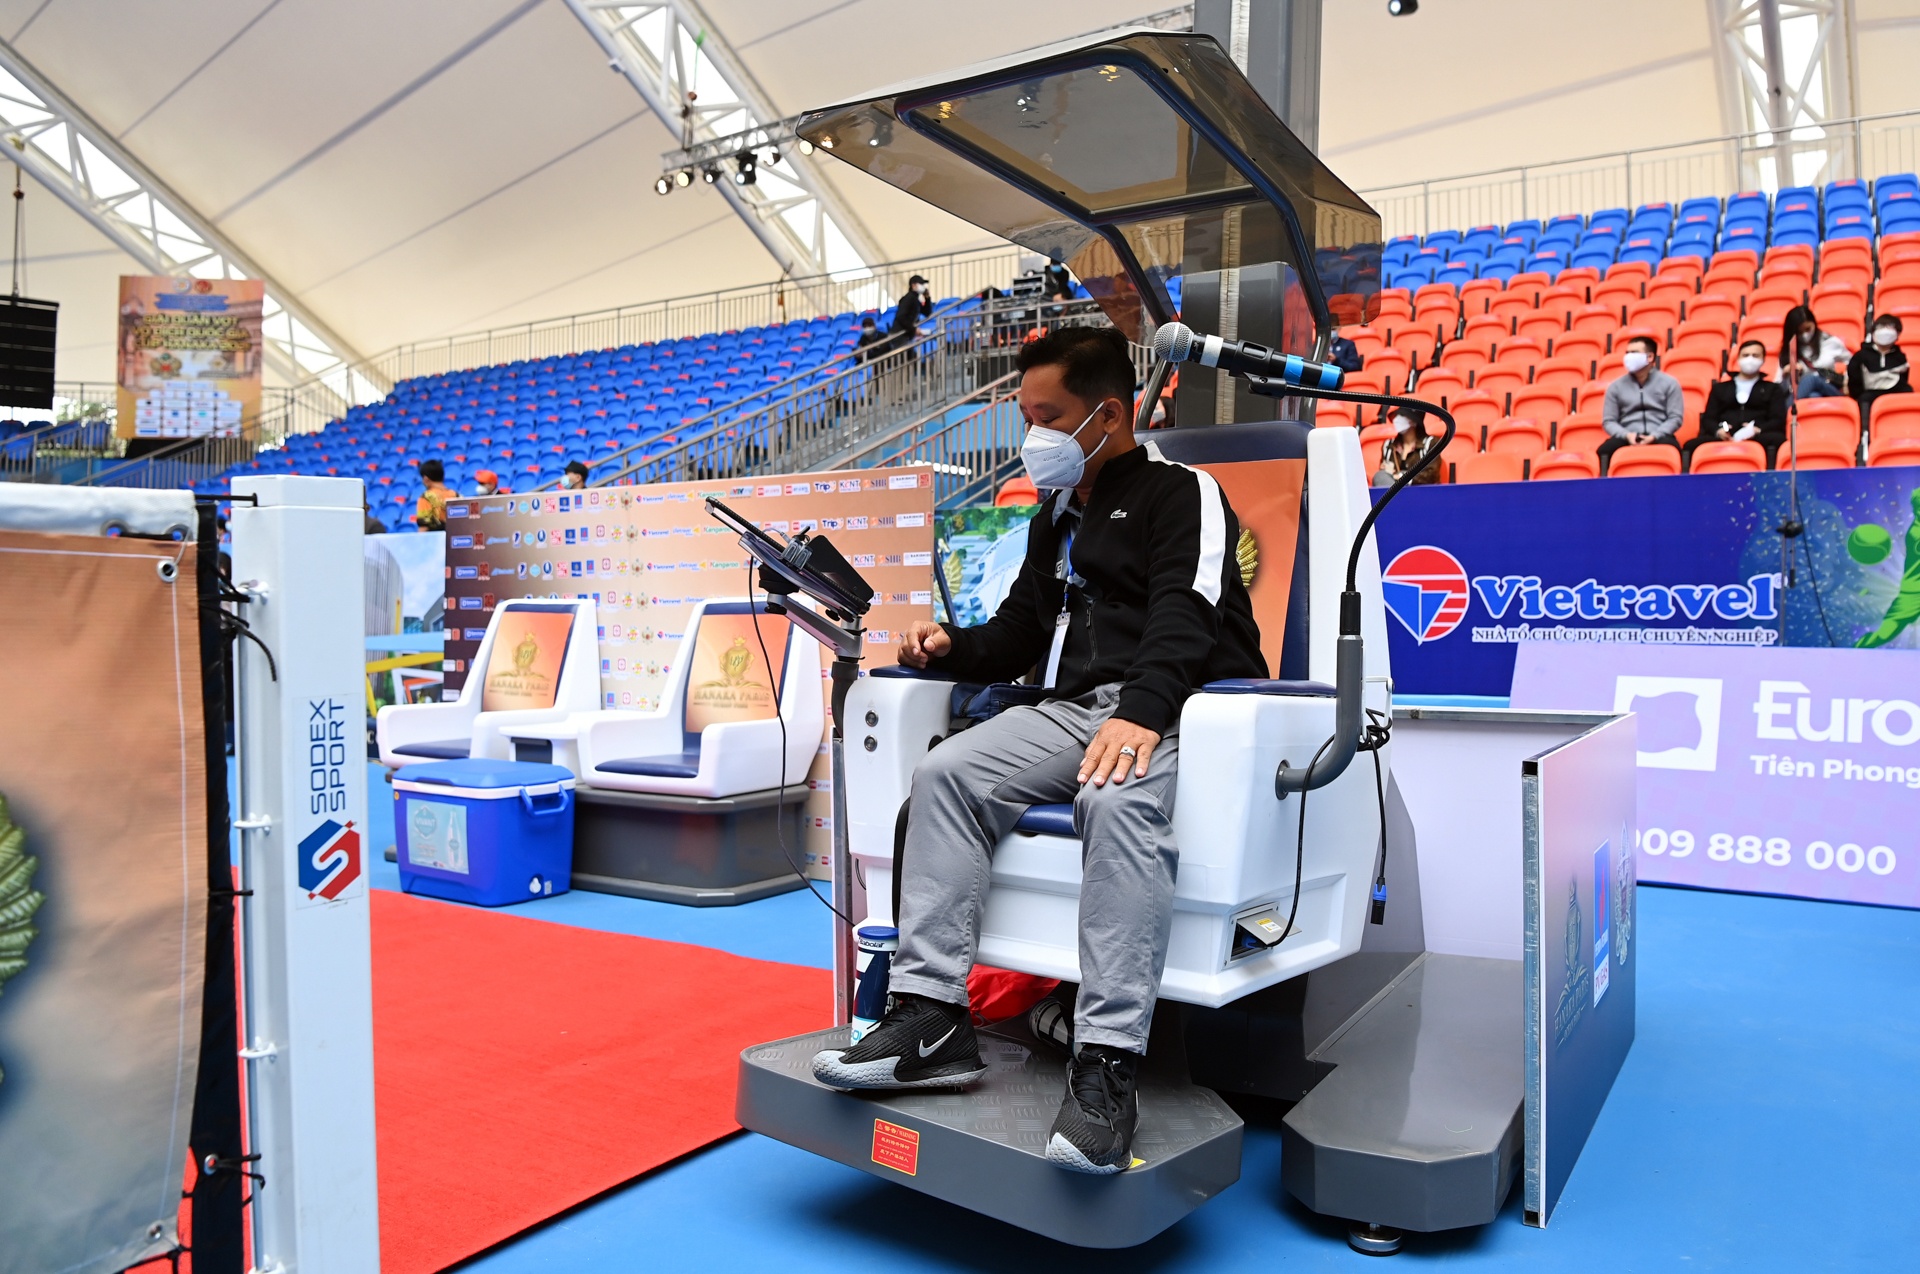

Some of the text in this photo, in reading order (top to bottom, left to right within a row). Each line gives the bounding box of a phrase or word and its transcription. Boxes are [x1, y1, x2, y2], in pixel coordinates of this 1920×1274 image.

[870, 478, 887, 487] SHB
[878, 516, 894, 525] SHB
[885, 554, 902, 563] SHB
[892, 592, 908, 601] SHB
[1472, 573, 1777, 620] Vietravel
[1474, 627, 1506, 641] NHÀ
[1532, 625, 1574, 642] CHỨC
[1577, 630, 1600, 642] DU
[1602, 630, 1640, 644] LỊCH
[1643, 626, 1708, 643] CHUYÊN
[1711, 628, 1777, 646] NGHIỆP
[309, 698, 327, 815] SODEX
[329, 697, 346, 812] SPORT
[1750, 754, 1815, 779] Tiên
[1637, 828, 1896, 876] 09 888 000
